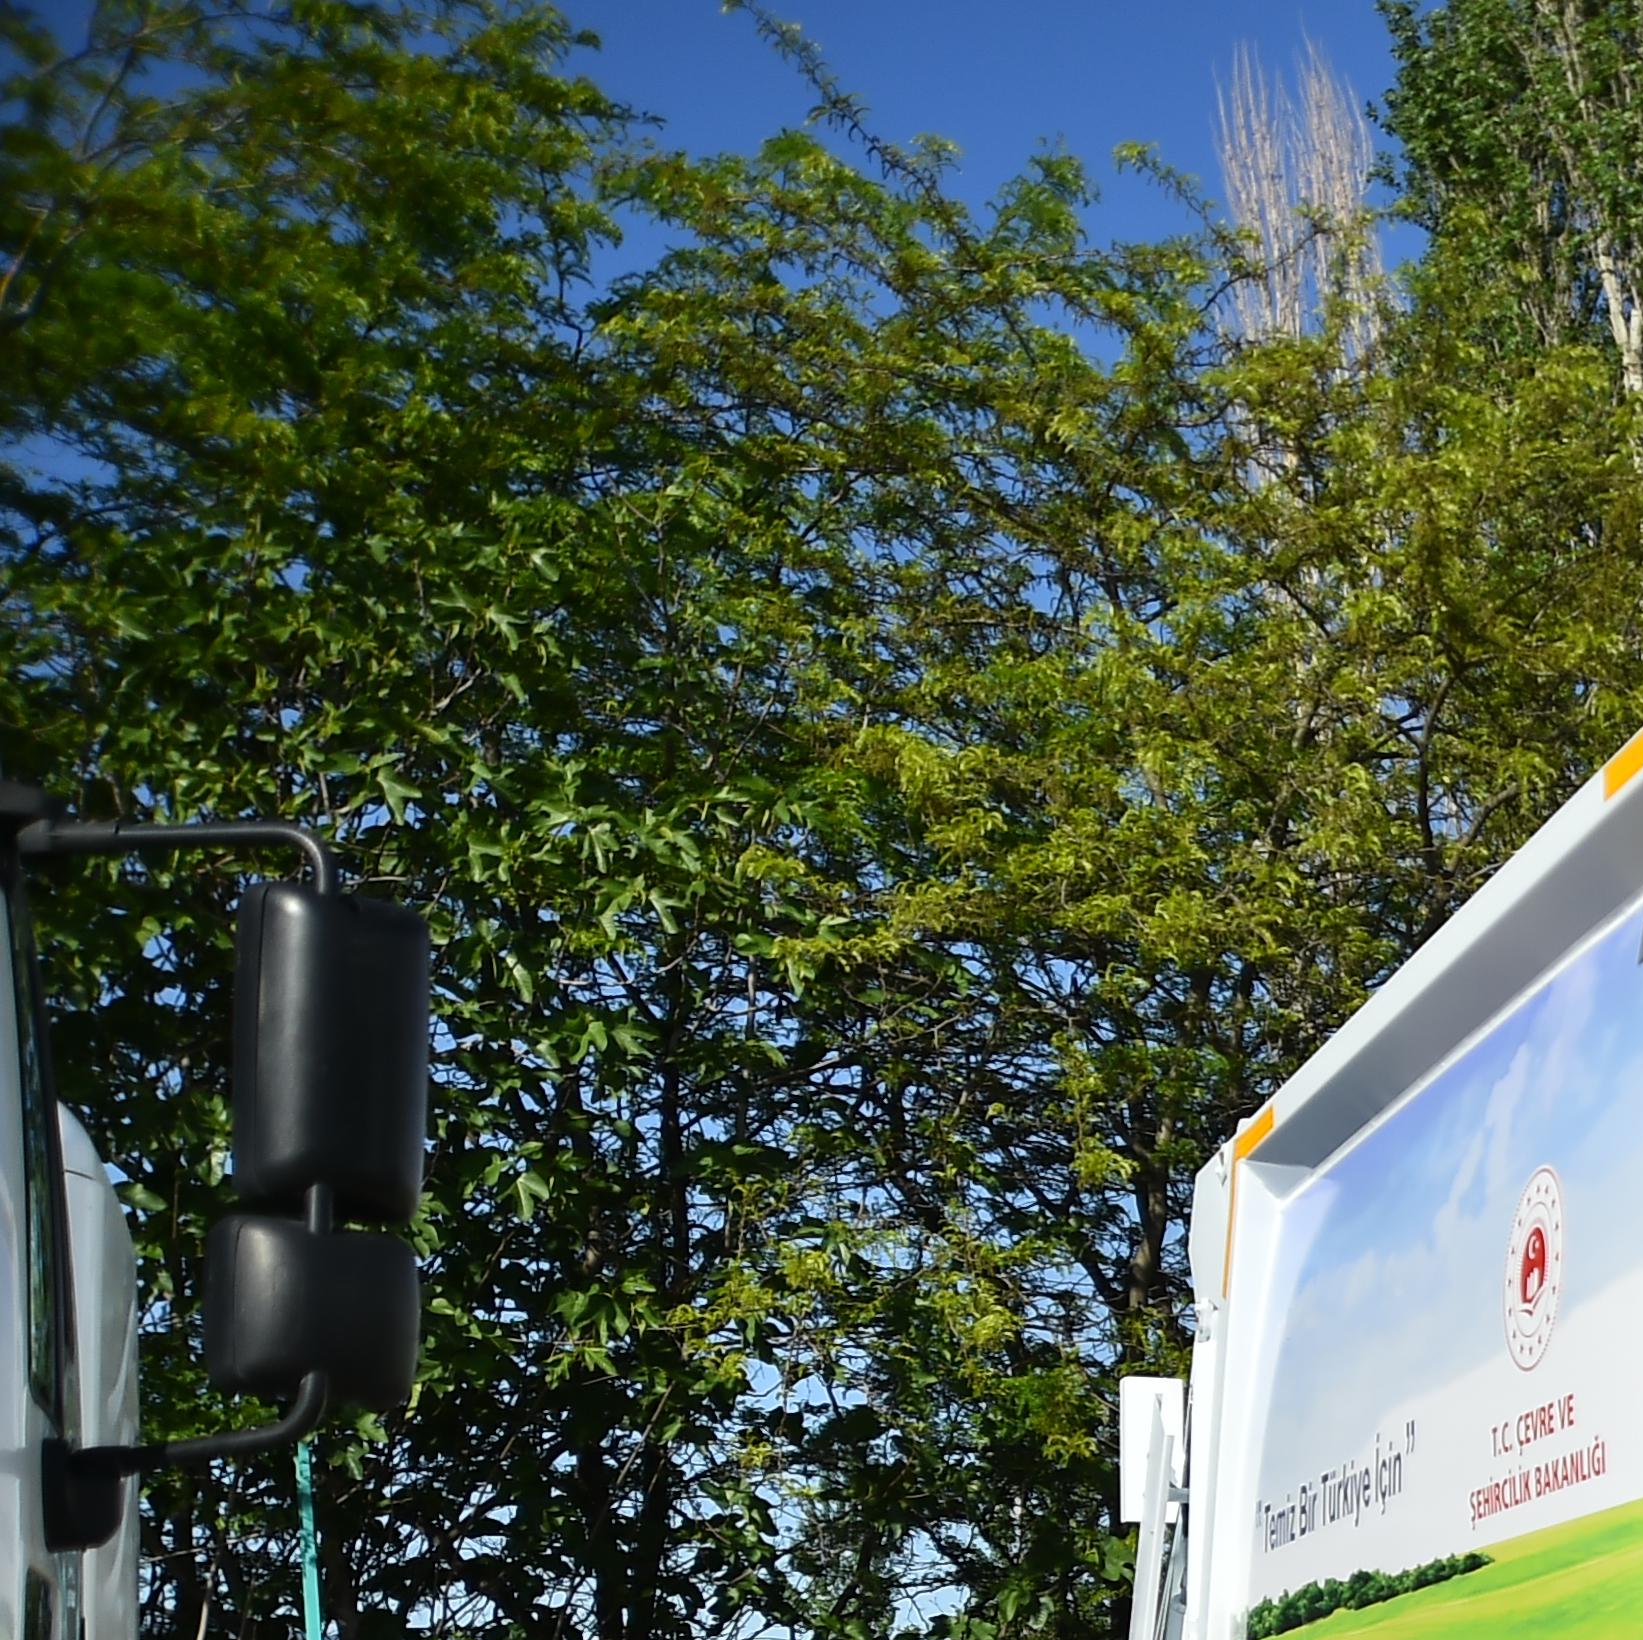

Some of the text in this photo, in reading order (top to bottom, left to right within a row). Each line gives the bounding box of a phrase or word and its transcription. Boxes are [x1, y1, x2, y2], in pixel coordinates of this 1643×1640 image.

[1491, 1393, 1575, 1457] T.C. ÇEVRE VE
[1299, 1481, 1318, 1537] Bir
[1321, 1459, 1371, 1527] Türkiye
[1469, 1435, 1606, 1531] ŞEHİRCİLİK BAKANLIĞI
